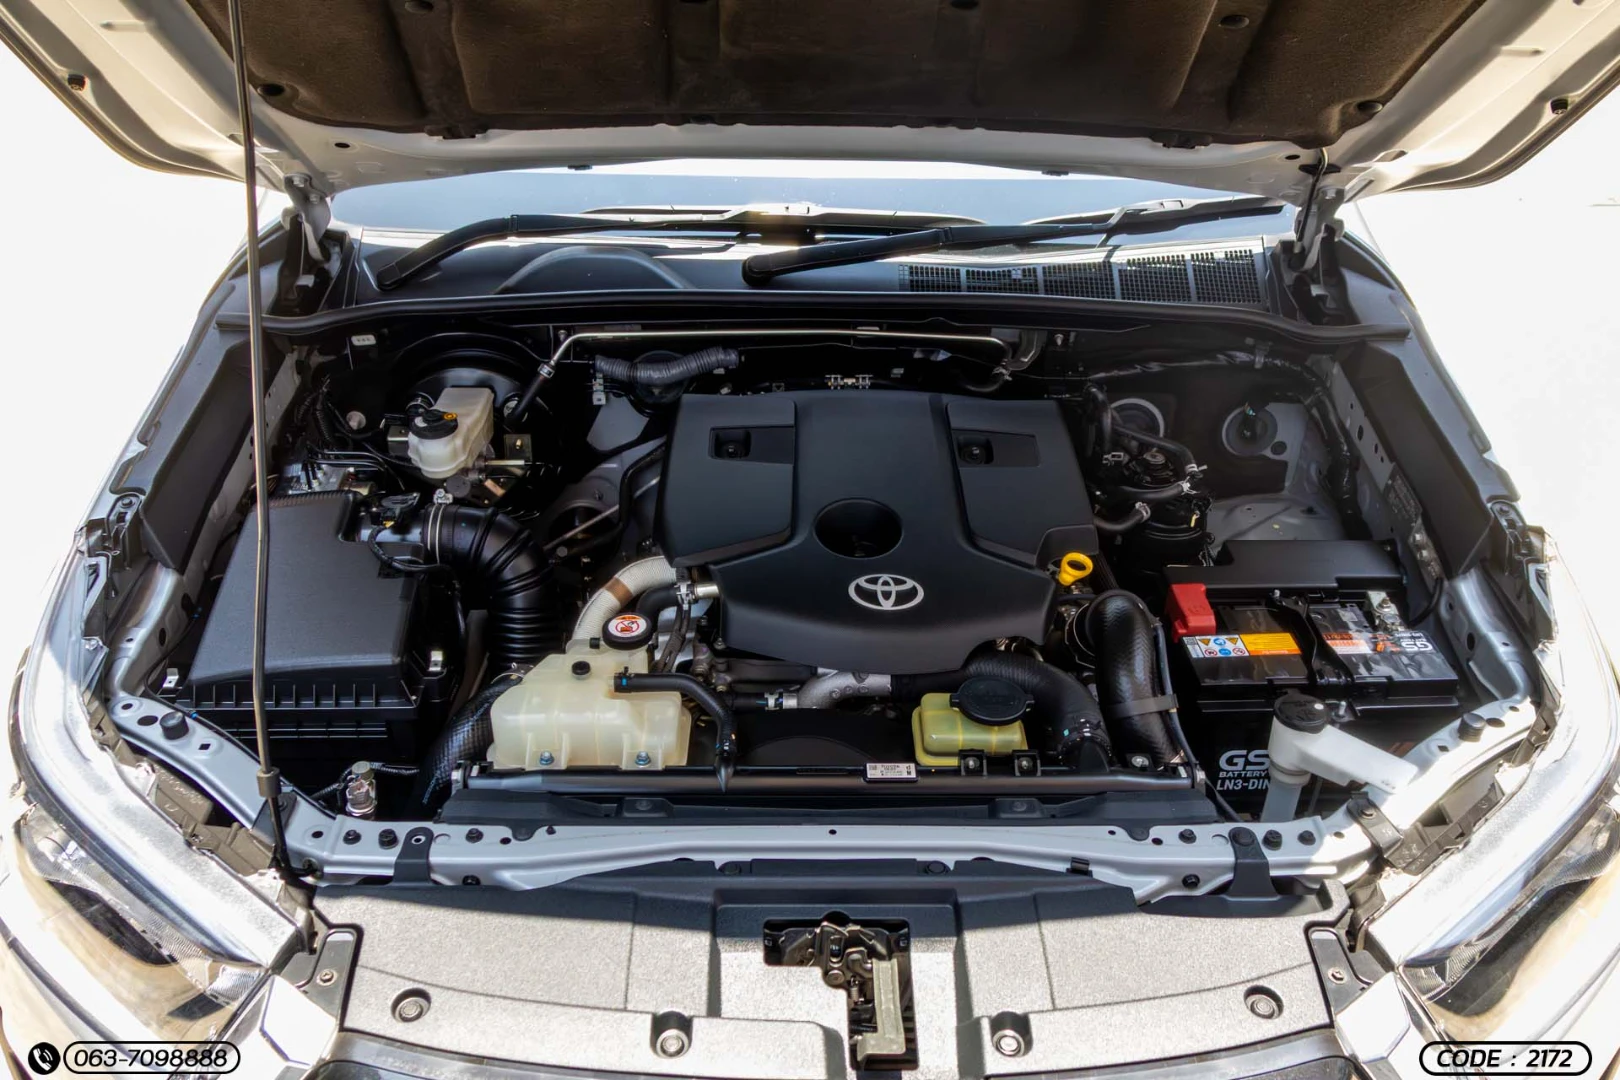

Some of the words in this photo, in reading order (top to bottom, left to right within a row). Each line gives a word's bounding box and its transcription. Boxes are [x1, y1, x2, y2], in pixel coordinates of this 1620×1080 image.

[1400, 641, 1433, 651] GS
[1219, 749, 1270, 771] GS
[1219, 770, 1268, 778] BATTERY
